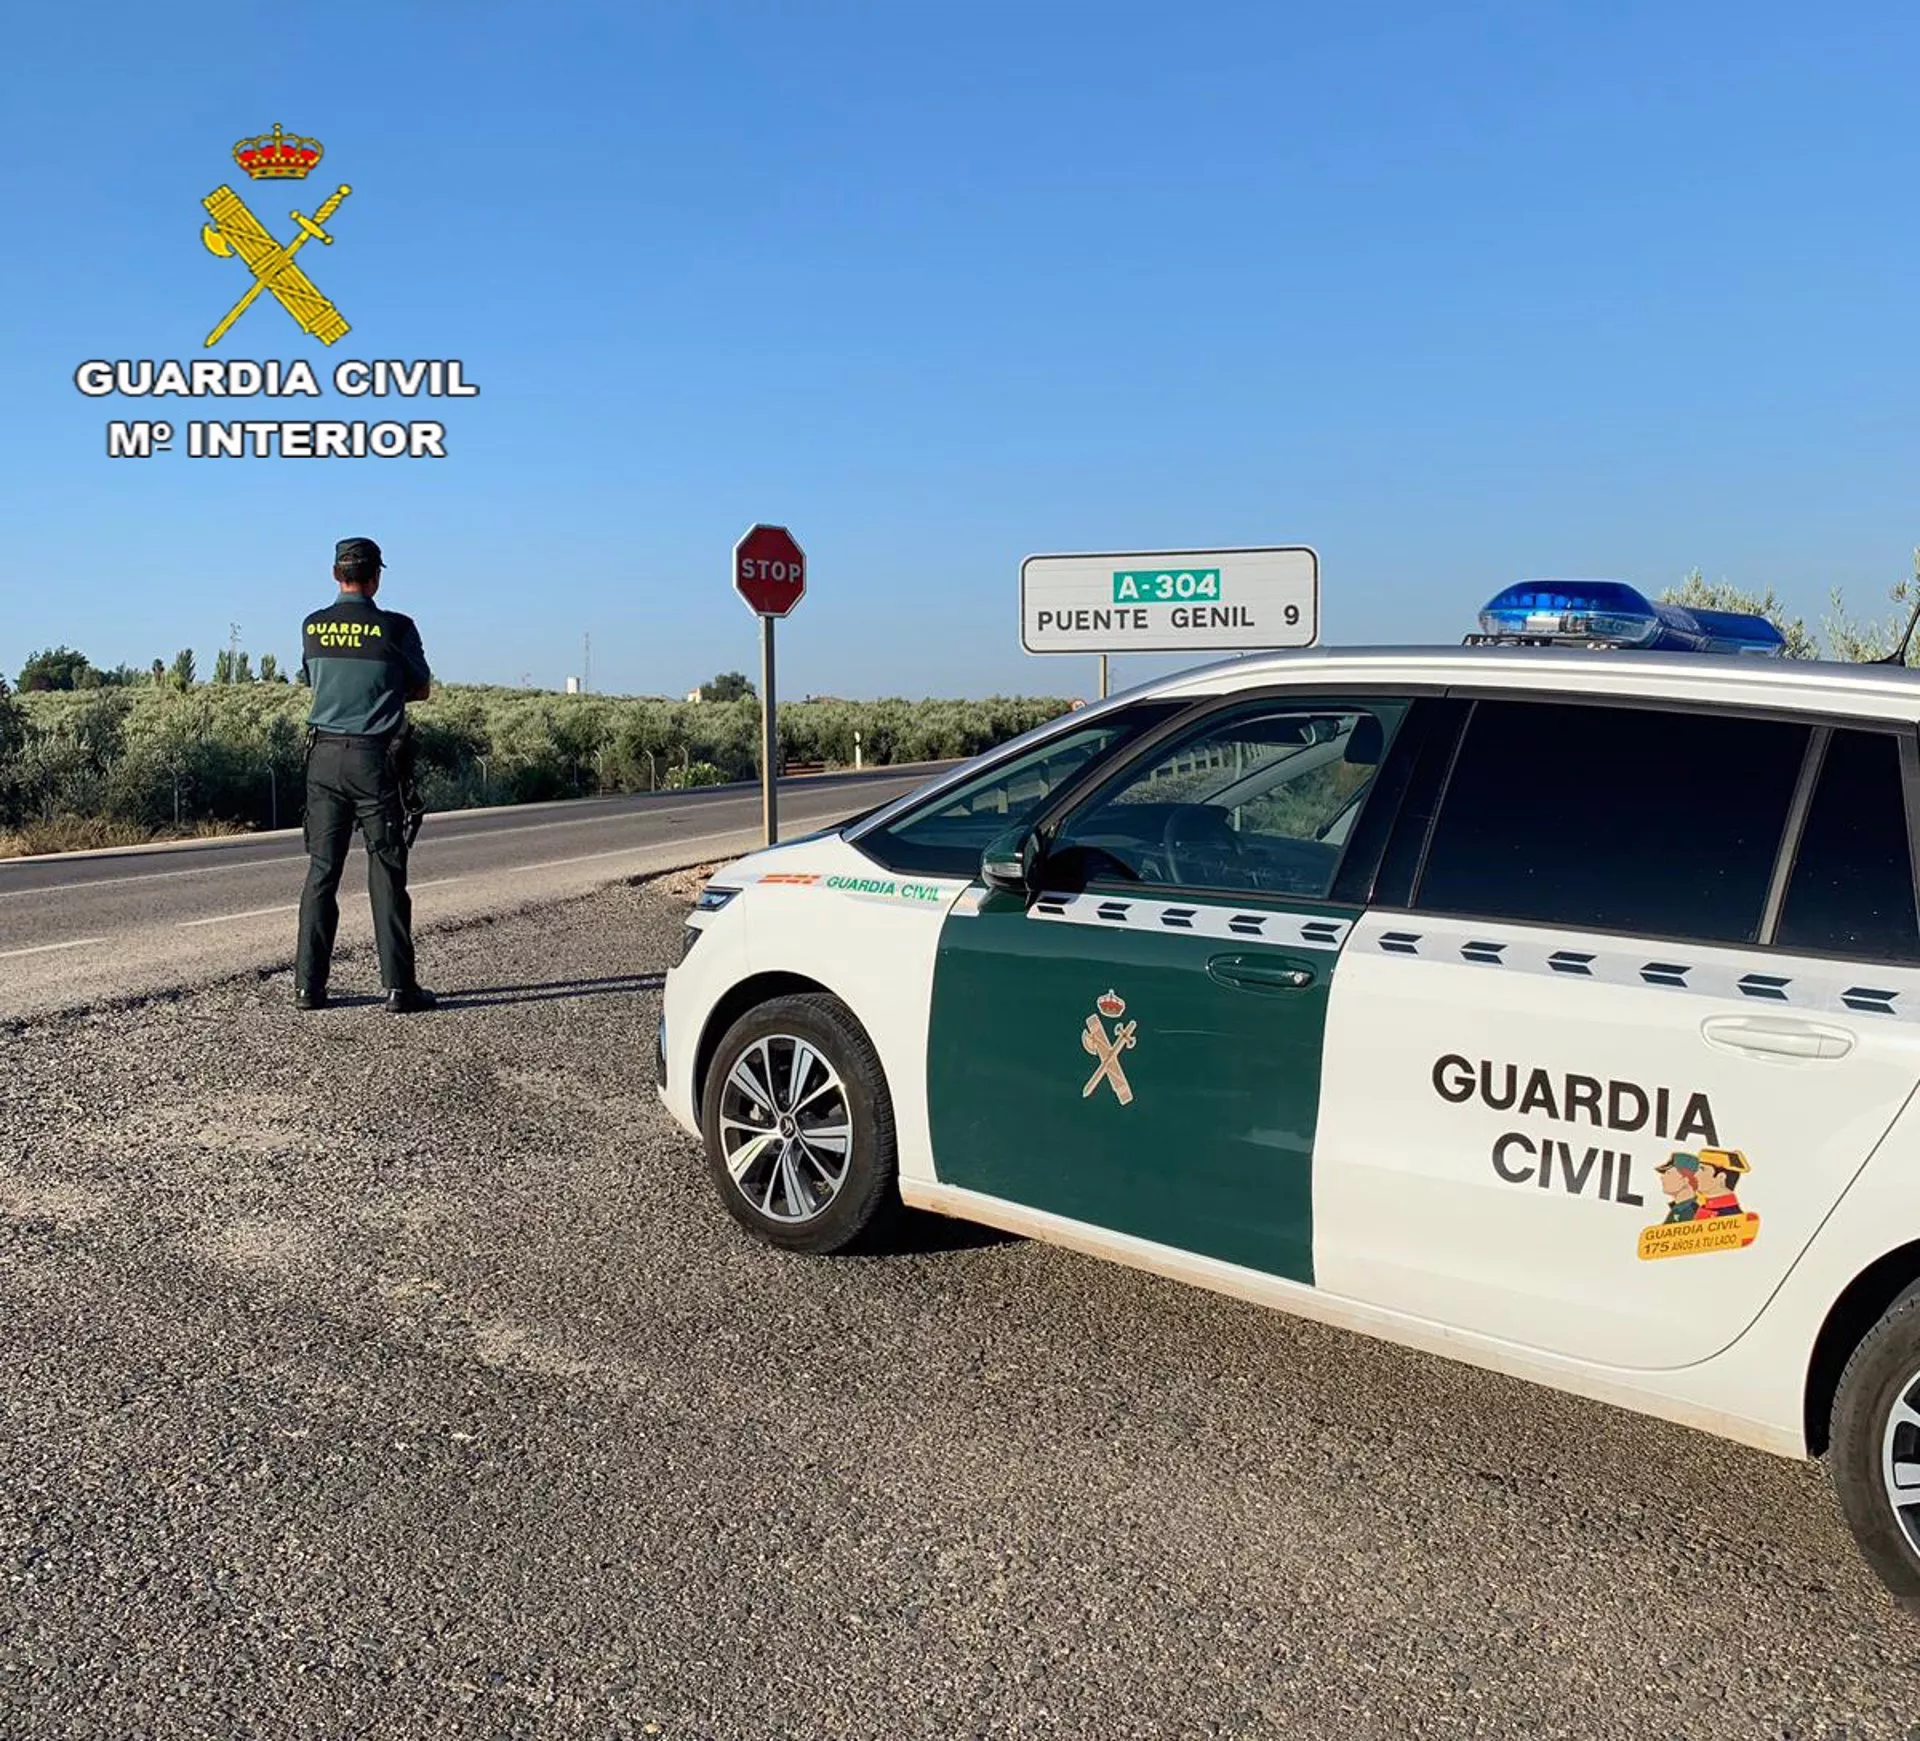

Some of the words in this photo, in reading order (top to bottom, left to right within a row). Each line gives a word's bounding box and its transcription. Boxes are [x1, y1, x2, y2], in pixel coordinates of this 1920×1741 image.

[741, 558, 802, 584] STOP
[1117, 573, 1218, 600] A-304
[306, 622, 382, 638] GUARDIA
[1037, 609, 1149, 632] PUENTE
[1170, 606, 1256, 629] GENIL
[1283, 604, 1301, 626] 9
[320, 634, 363, 648] CIVIL
[826, 876, 896, 896] GUARDIA
[901, 884, 940, 902] CIVIL
[1431, 1053, 1721, 1148] GUARDIA
[1491, 1131, 1644, 1207] CIVIL
[1645, 1222, 1704, 1241] GUARDIA
[1707, 1218, 1742, 1233] CIVIL
[1644, 1240, 1670, 1255] 175
